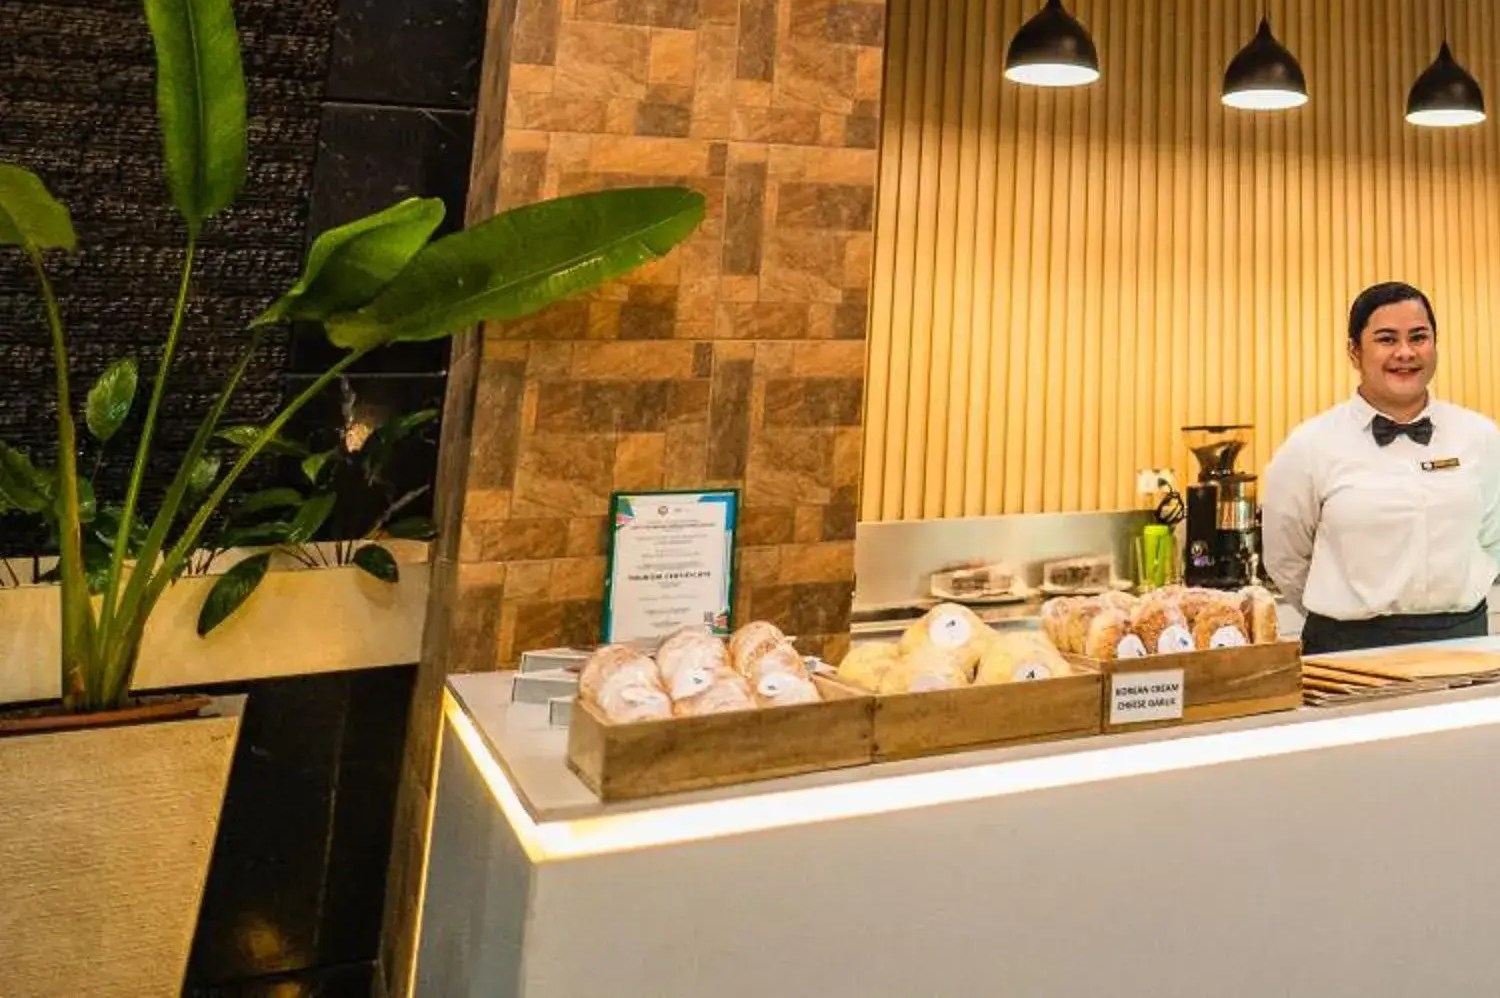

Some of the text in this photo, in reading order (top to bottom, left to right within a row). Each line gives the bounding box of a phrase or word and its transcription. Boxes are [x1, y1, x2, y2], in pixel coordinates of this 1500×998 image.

[1116, 683, 1179, 696] KOREAN CREAM
[1118, 699, 1146, 710] CHEESE
